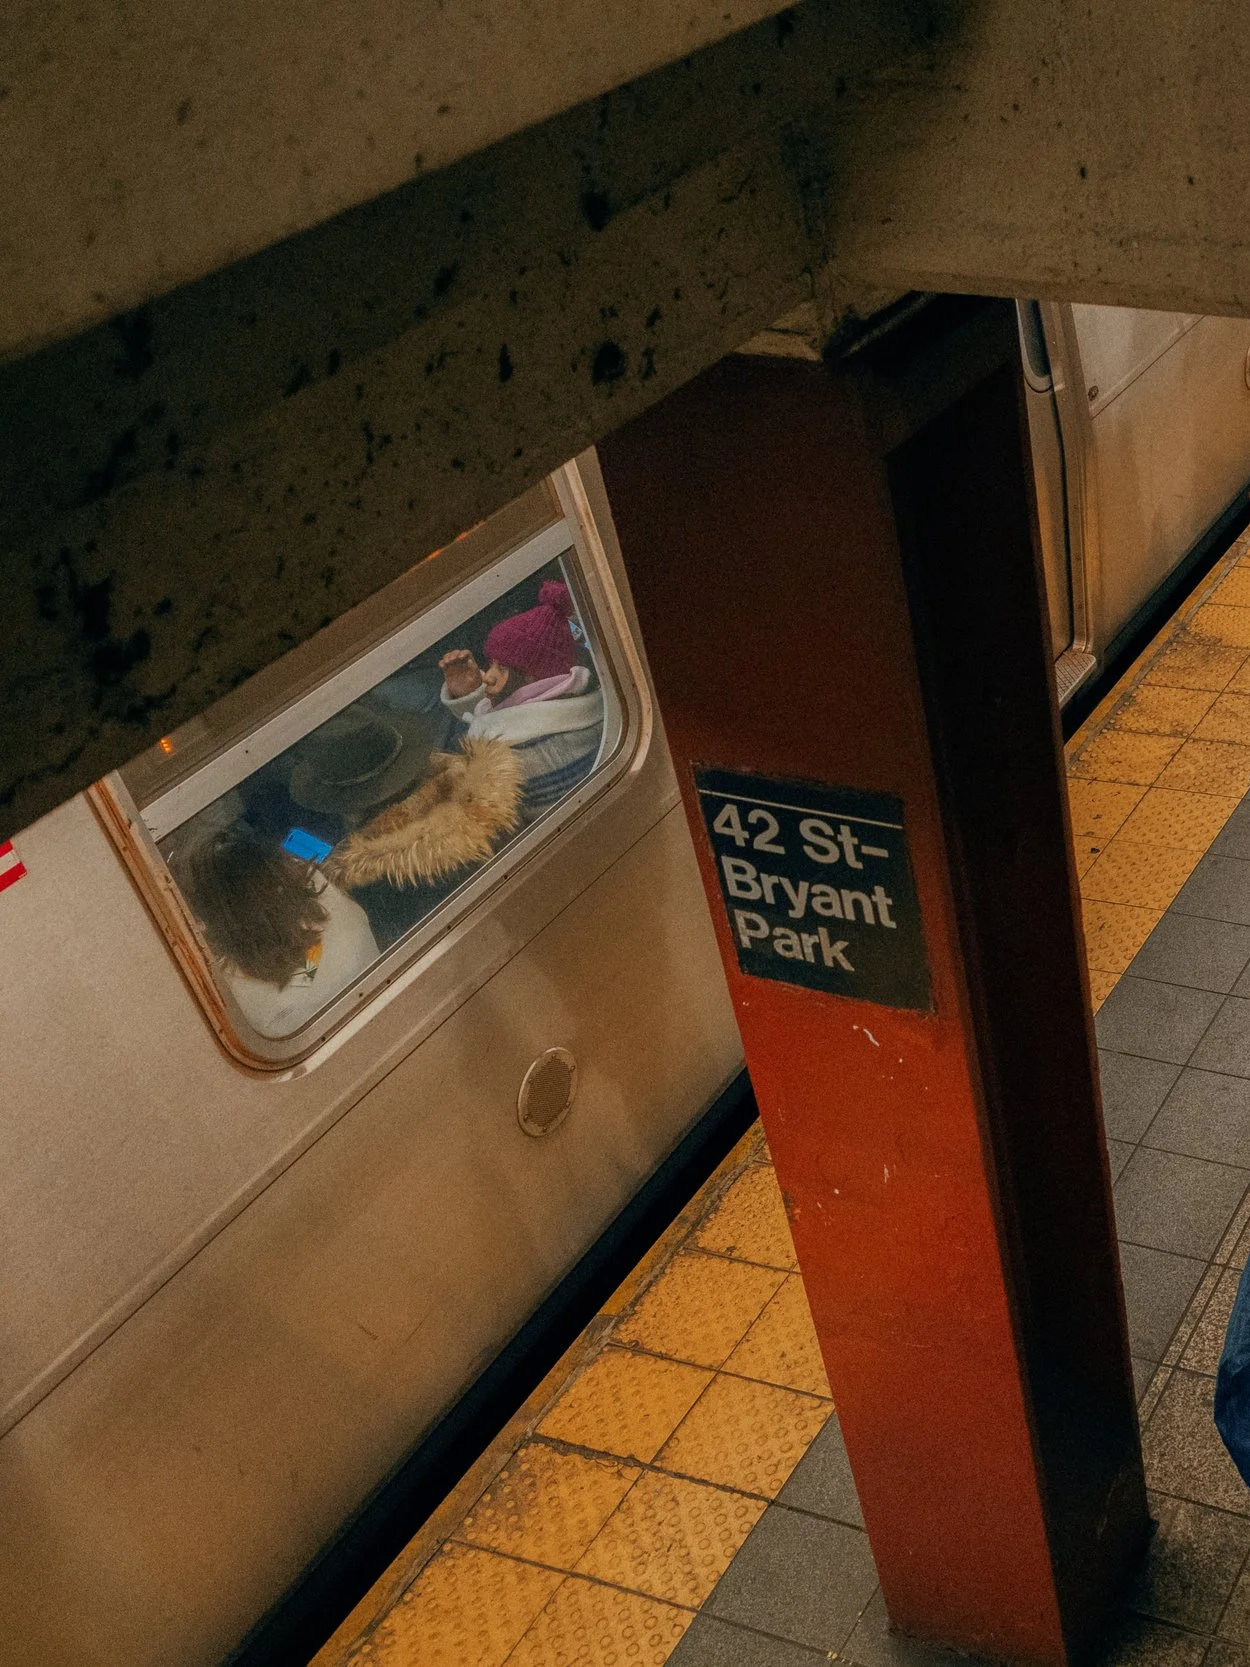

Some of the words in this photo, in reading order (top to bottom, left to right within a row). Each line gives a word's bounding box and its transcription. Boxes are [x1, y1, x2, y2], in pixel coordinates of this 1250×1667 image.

[713, 804, 785, 855] 42
[799, 818, 889, 869] St-
[721, 855, 896, 929] Bryant
[734, 908, 855, 972] Park
